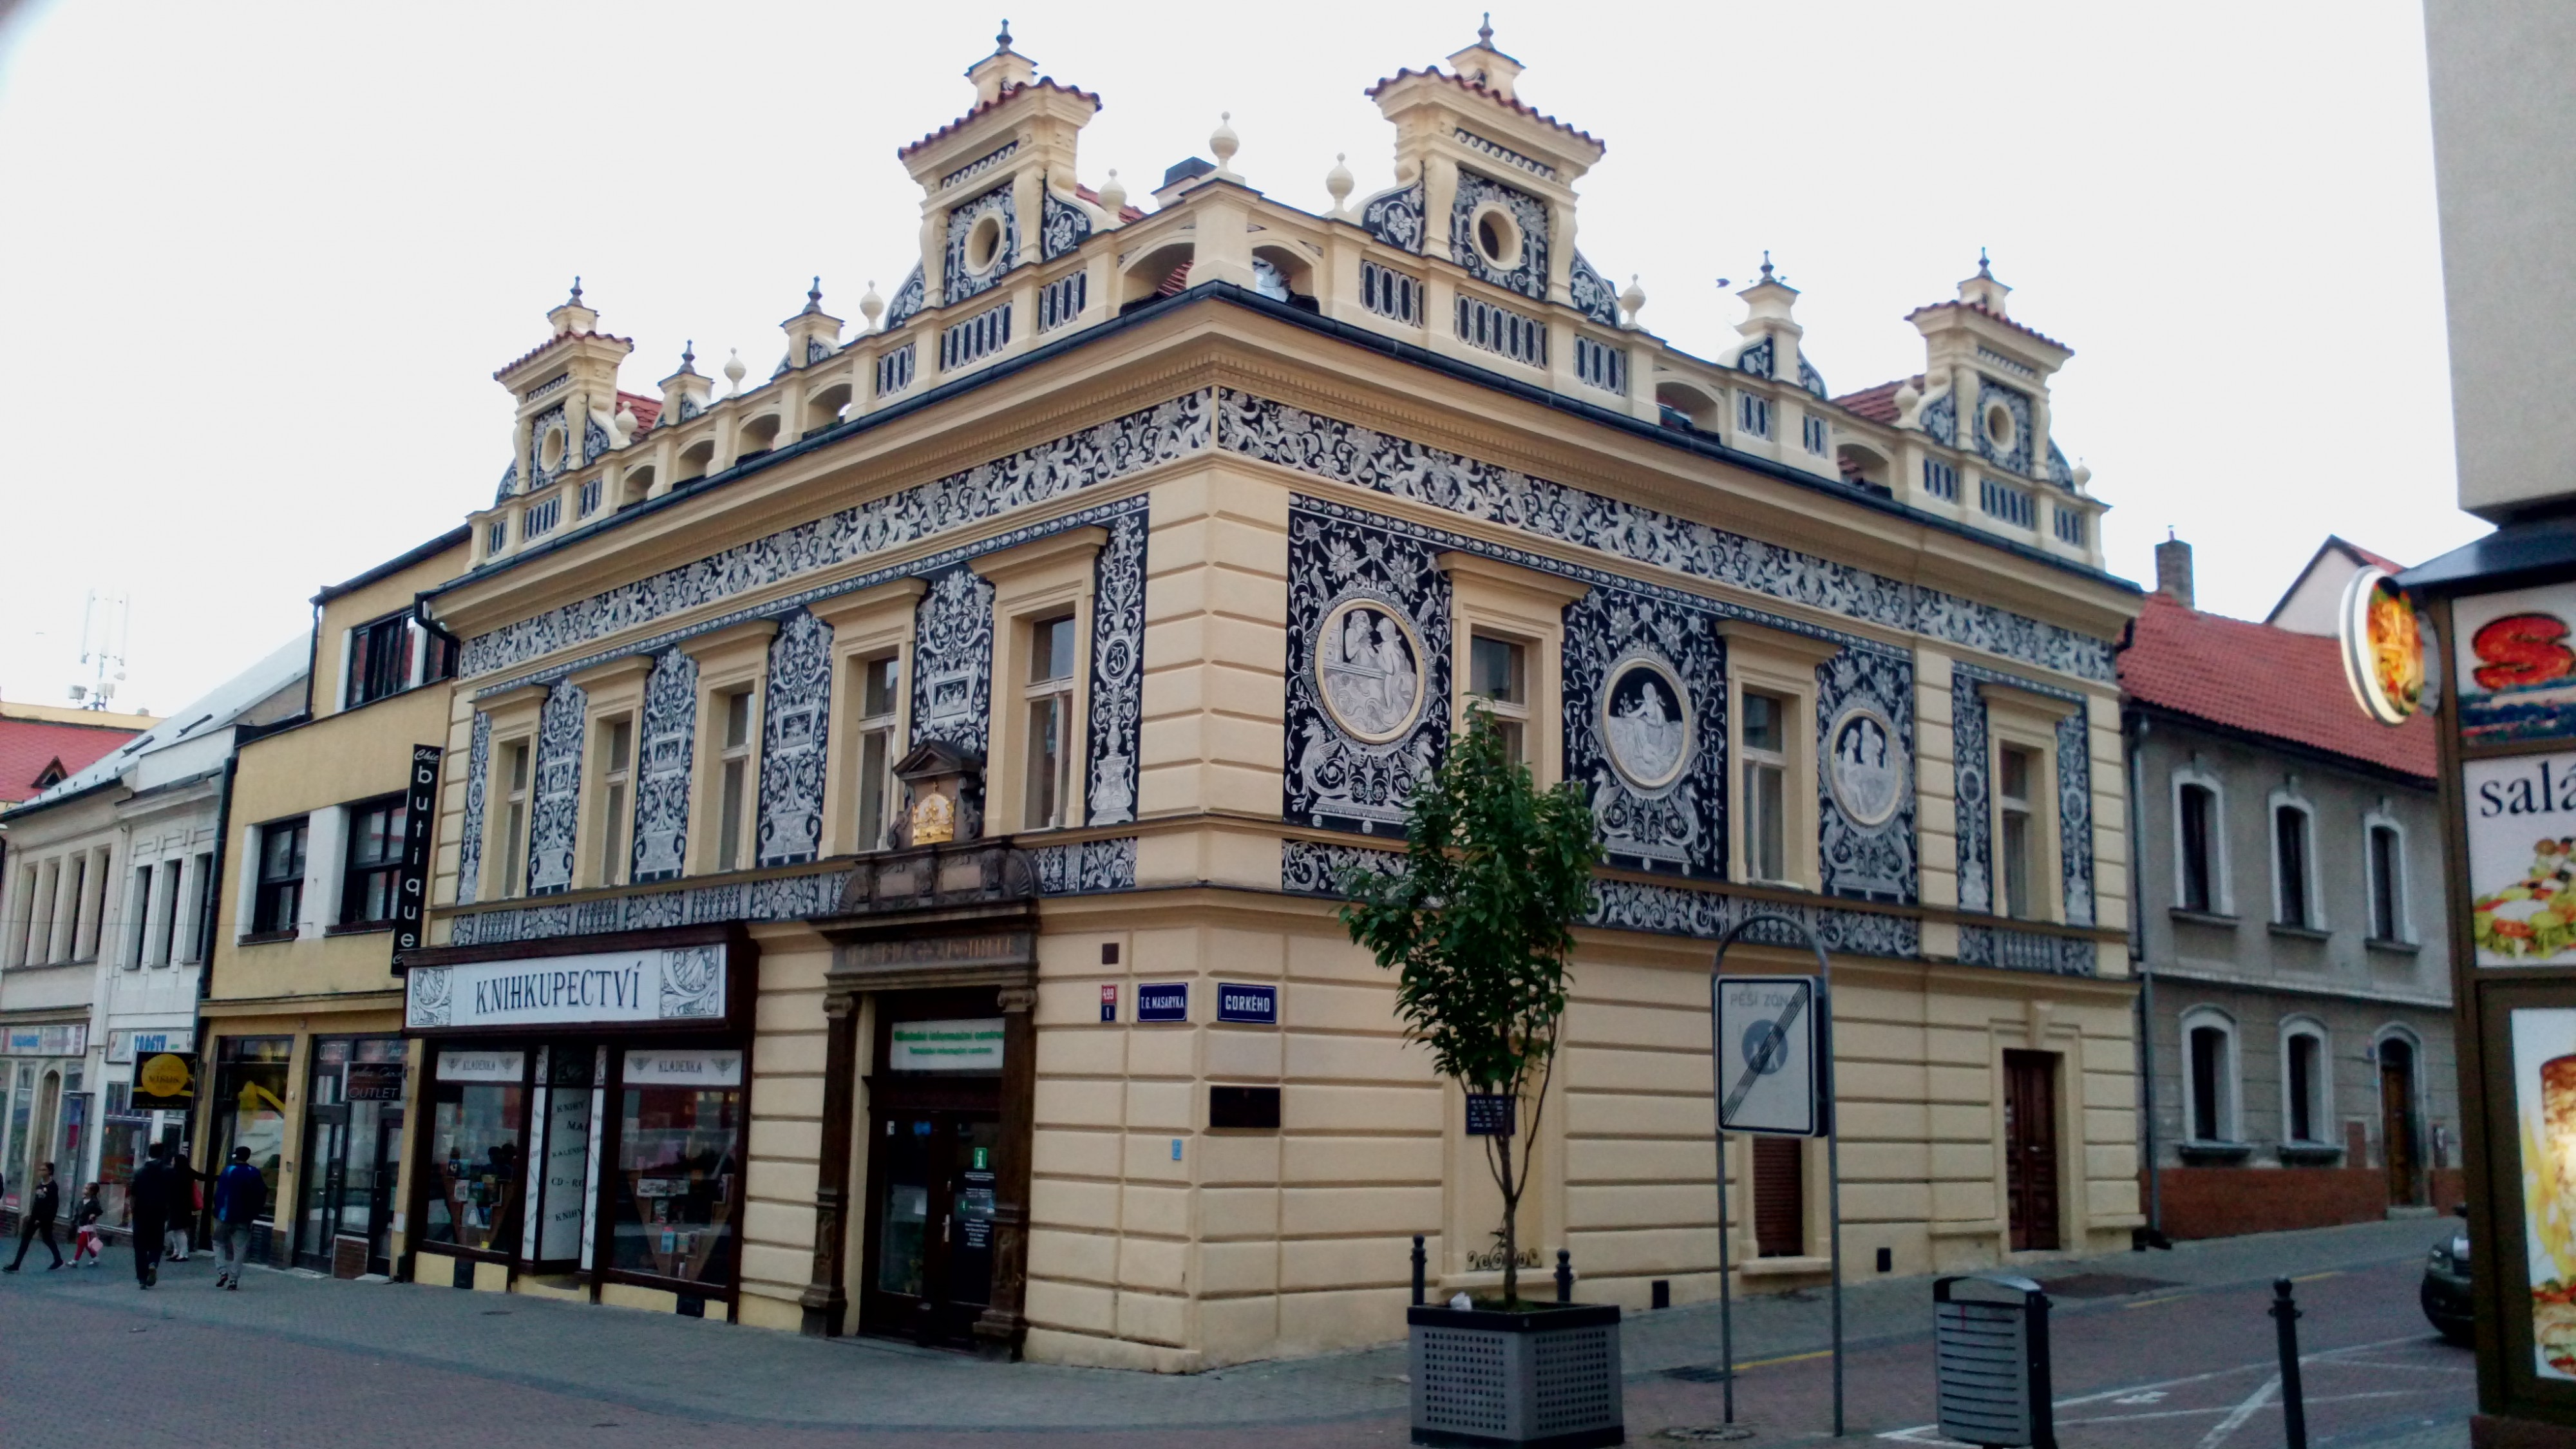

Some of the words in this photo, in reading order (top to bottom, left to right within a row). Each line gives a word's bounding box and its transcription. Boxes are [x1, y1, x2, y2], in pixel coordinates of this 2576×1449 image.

[476, 960, 642, 1015] KNIHKUPECTVÍ
[1102, 988, 1114, 1000] 499
[1151, 996, 1185, 1009] MASARYKA
[1225, 994, 1270, 1012] GORKÉHO
[1105, 1007, 1110, 1019] 1
[463, 1059, 495, 1070] KLADENKA
[659, 1060, 702, 1073] KLADENKA
[348, 1087, 399, 1099] OUTLET
[556, 1099, 585, 1113] KNIHY
[551, 1177, 564, 1186] CD
